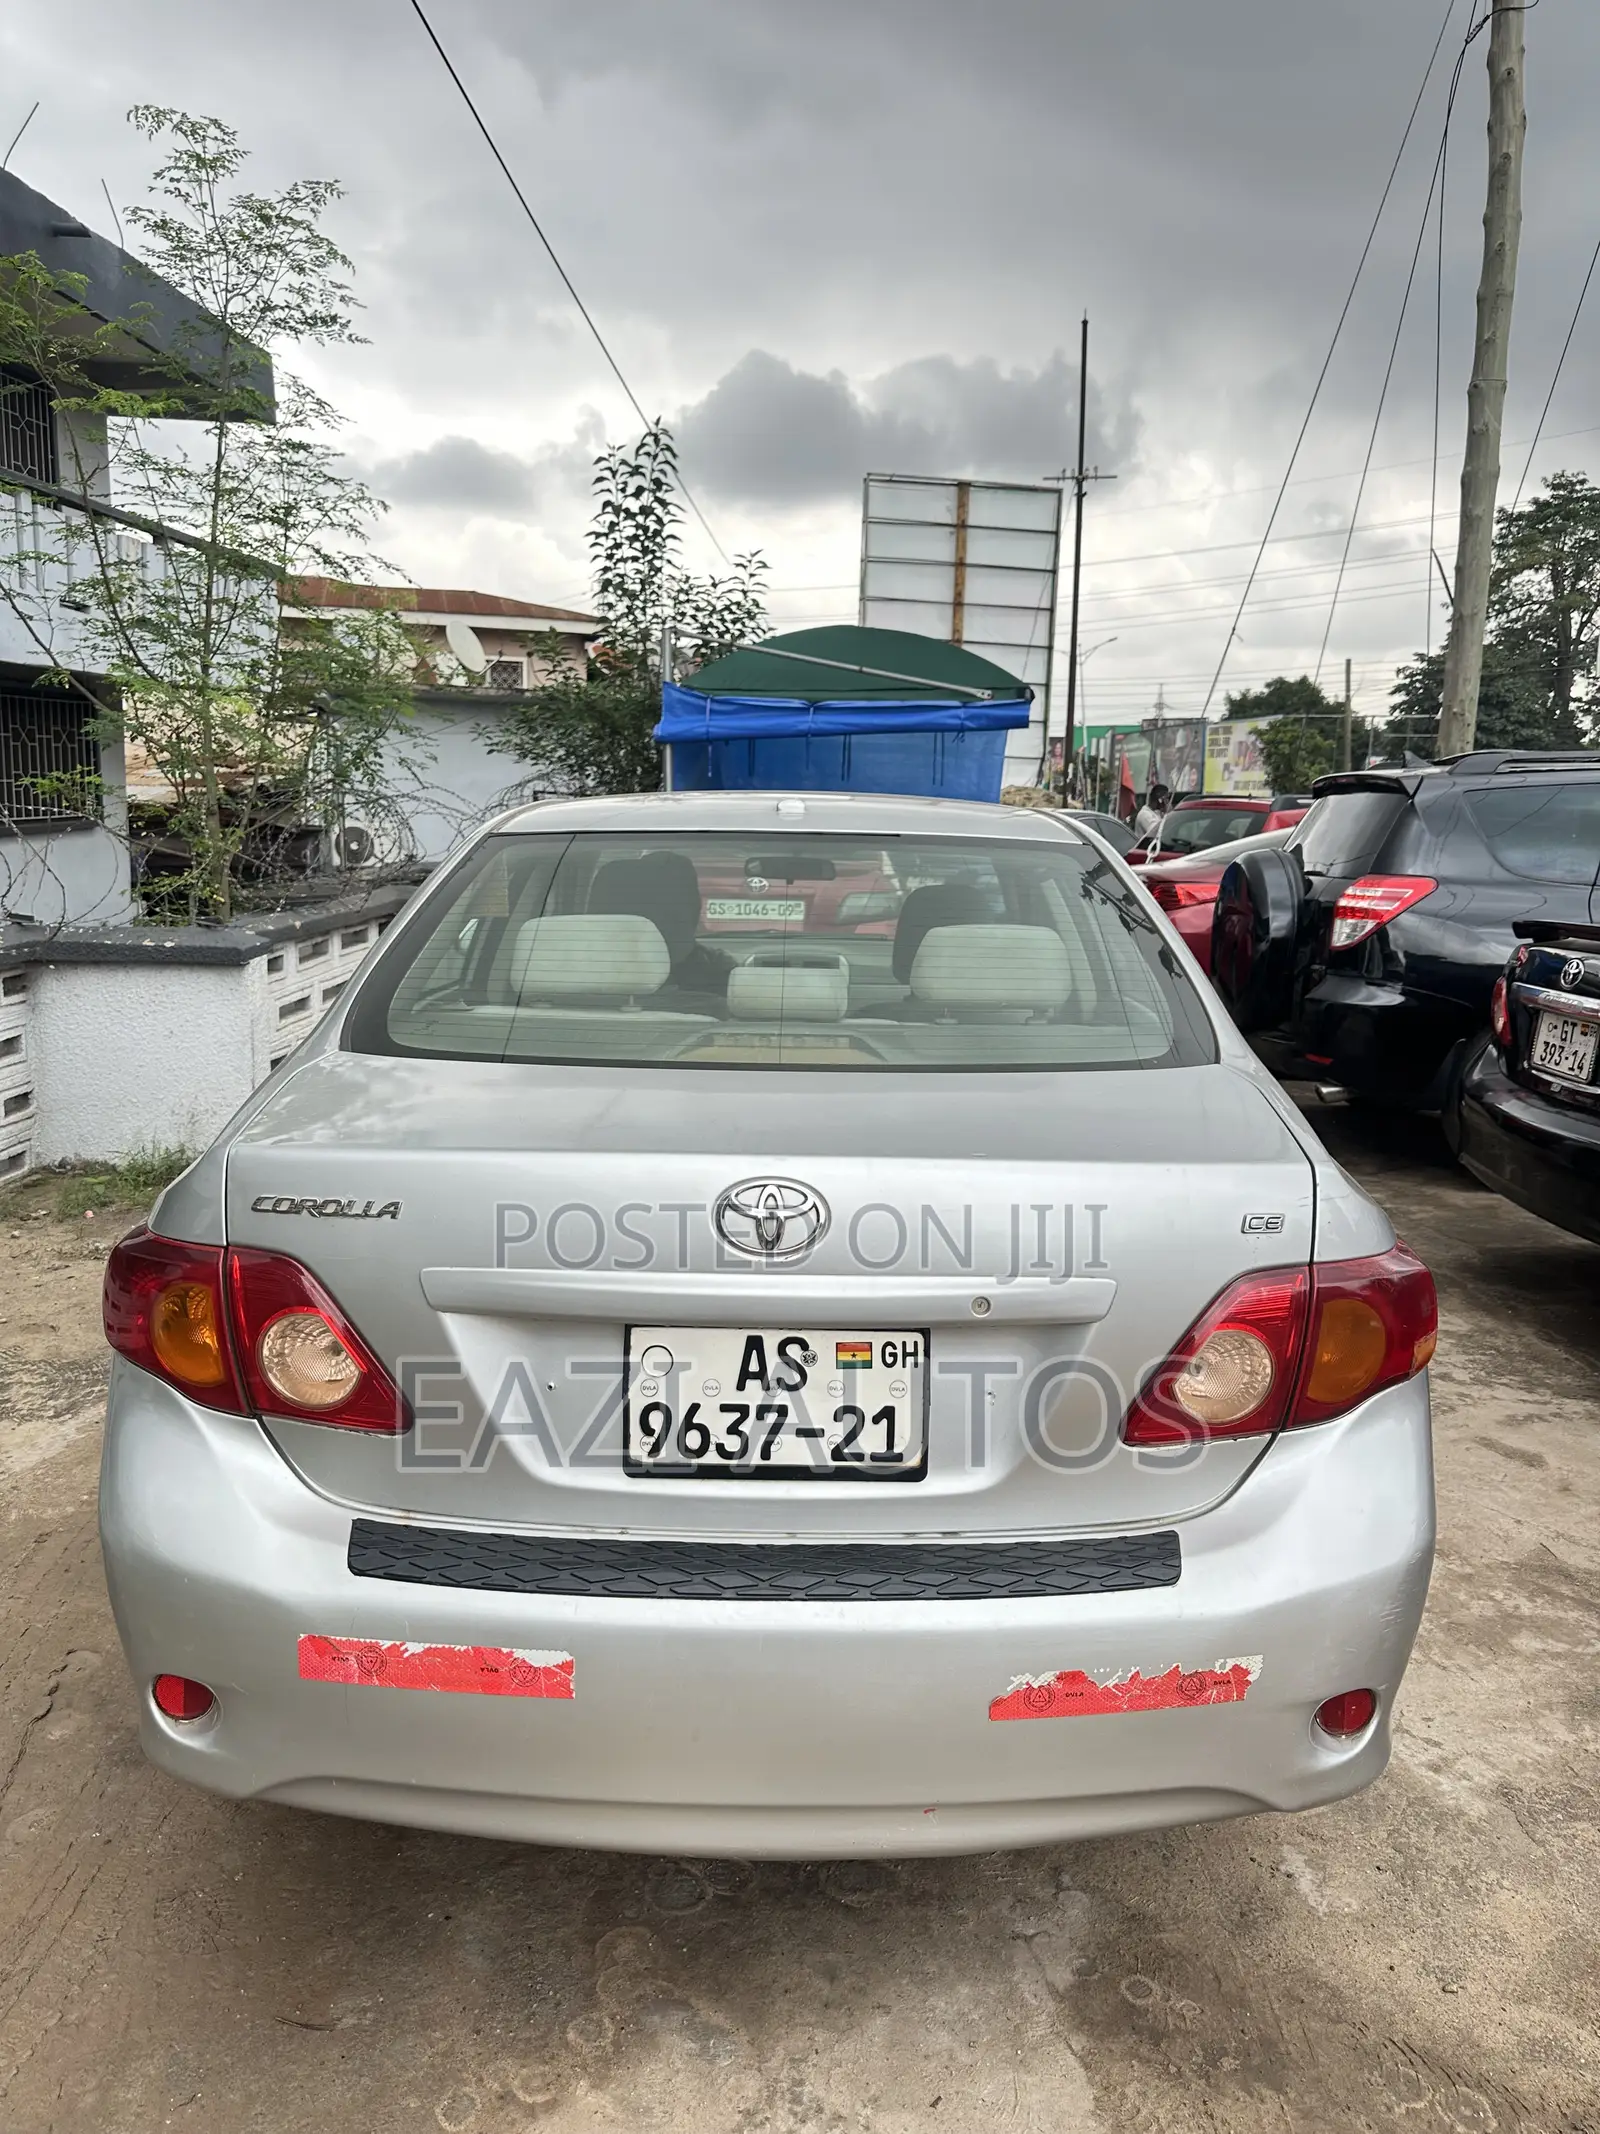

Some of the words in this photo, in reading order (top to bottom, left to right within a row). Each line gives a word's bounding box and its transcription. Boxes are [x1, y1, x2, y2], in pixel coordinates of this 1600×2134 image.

[709, 902, 726, 916] GS
[1560, 1020, 1578, 1043] GT
[1540, 1041, 1587, 1074] 393-14
[251, 1195, 403, 1220] COROLLA
[1247, 1215, 1282, 1231] CE
[736, 1335, 809, 1392] AS
[881, 1340, 919, 1369] GH
[639, 1401, 904, 1462] 9637-21
